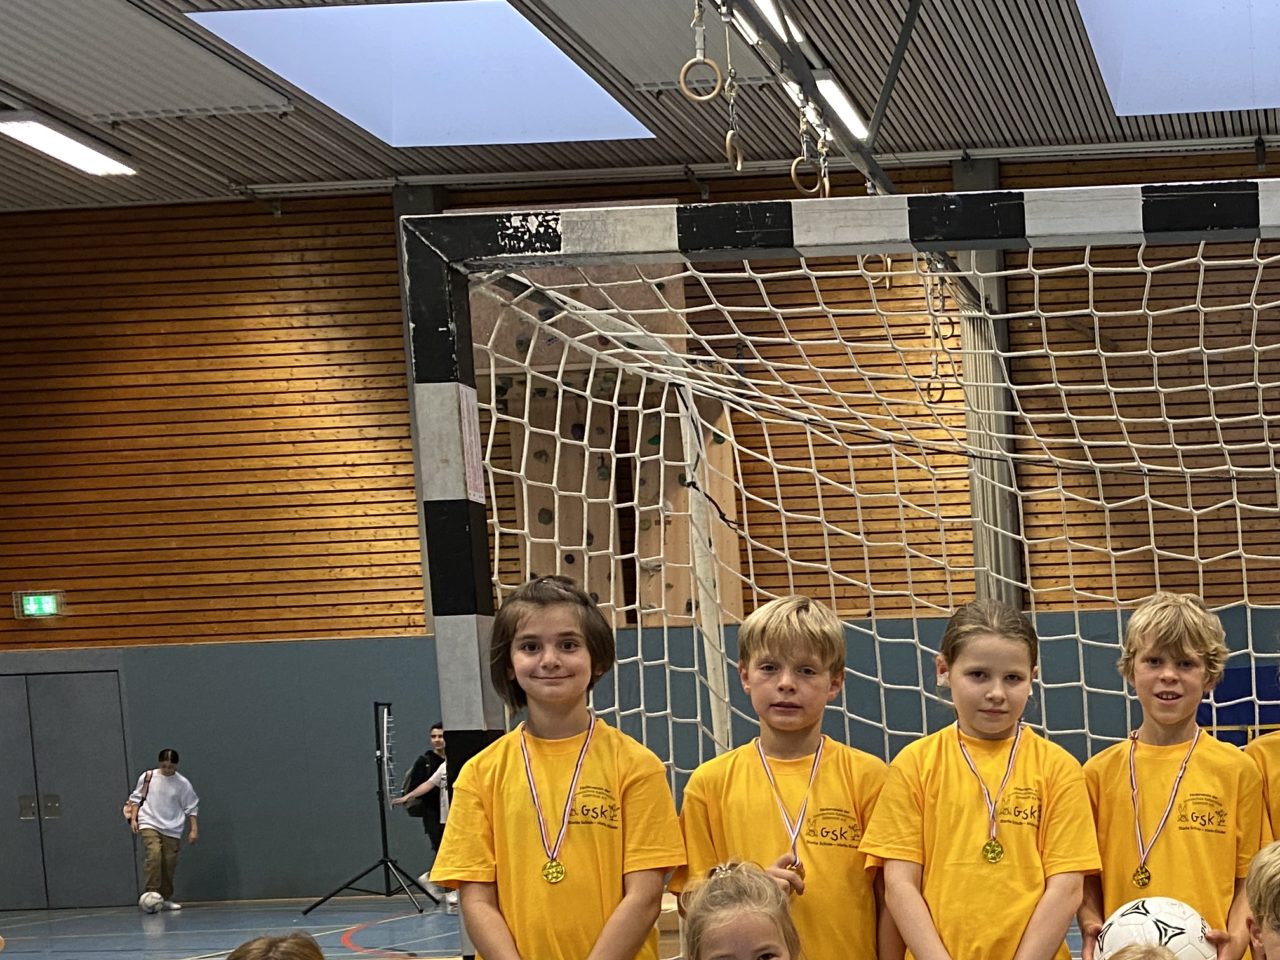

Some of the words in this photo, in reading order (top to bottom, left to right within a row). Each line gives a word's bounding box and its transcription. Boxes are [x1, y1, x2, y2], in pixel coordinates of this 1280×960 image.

[581, 804, 608, 819] GSK
[1013, 806, 1037, 820] GSK
[1191, 811, 1214, 827] GSK
[820, 827, 848, 841] GSK
